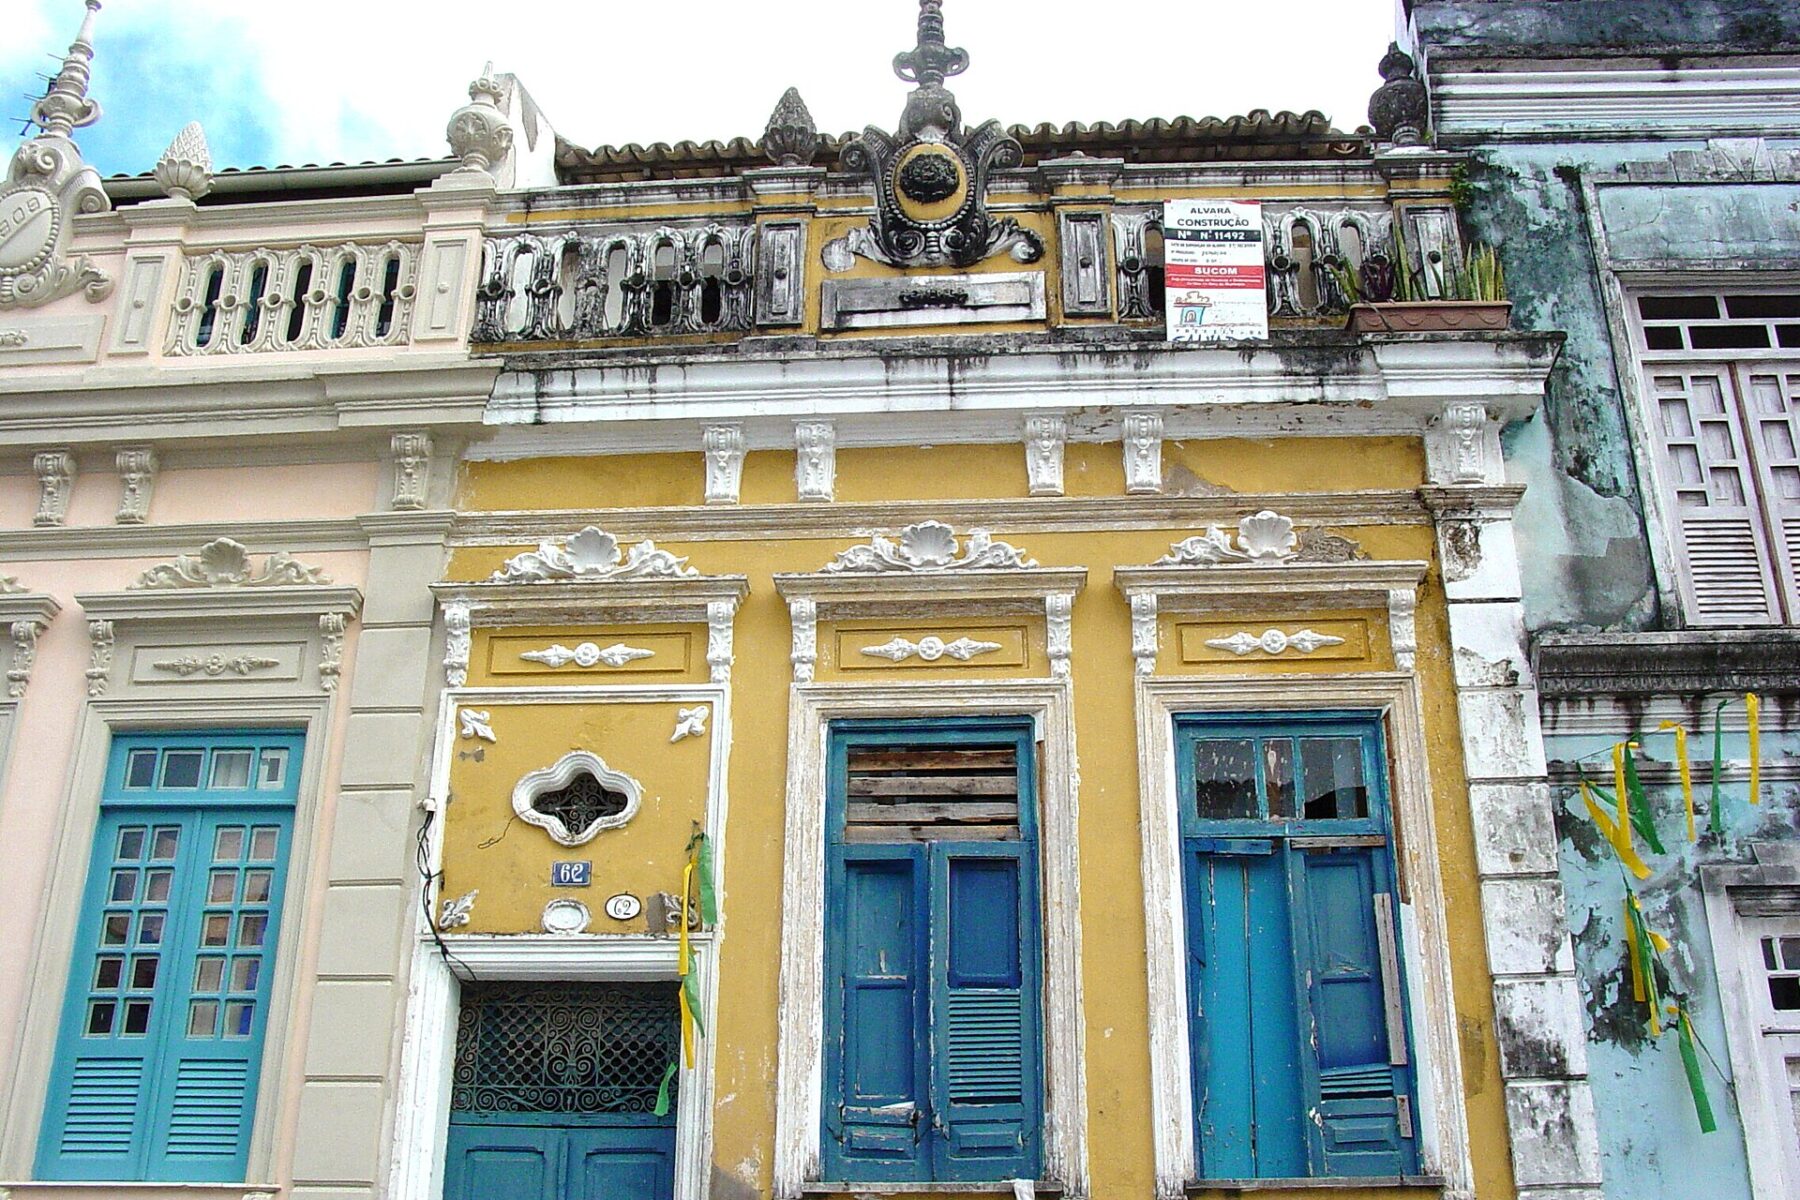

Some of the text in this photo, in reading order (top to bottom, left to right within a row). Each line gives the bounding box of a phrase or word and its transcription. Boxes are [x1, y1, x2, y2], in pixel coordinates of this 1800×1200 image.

[1177, 217, 1249, 227] CONSTRUÇÃO
[1214, 231, 1246, 240] 11492
[1194, 267, 1238, 275] SUCOM
[560, 863, 584, 882] 62
